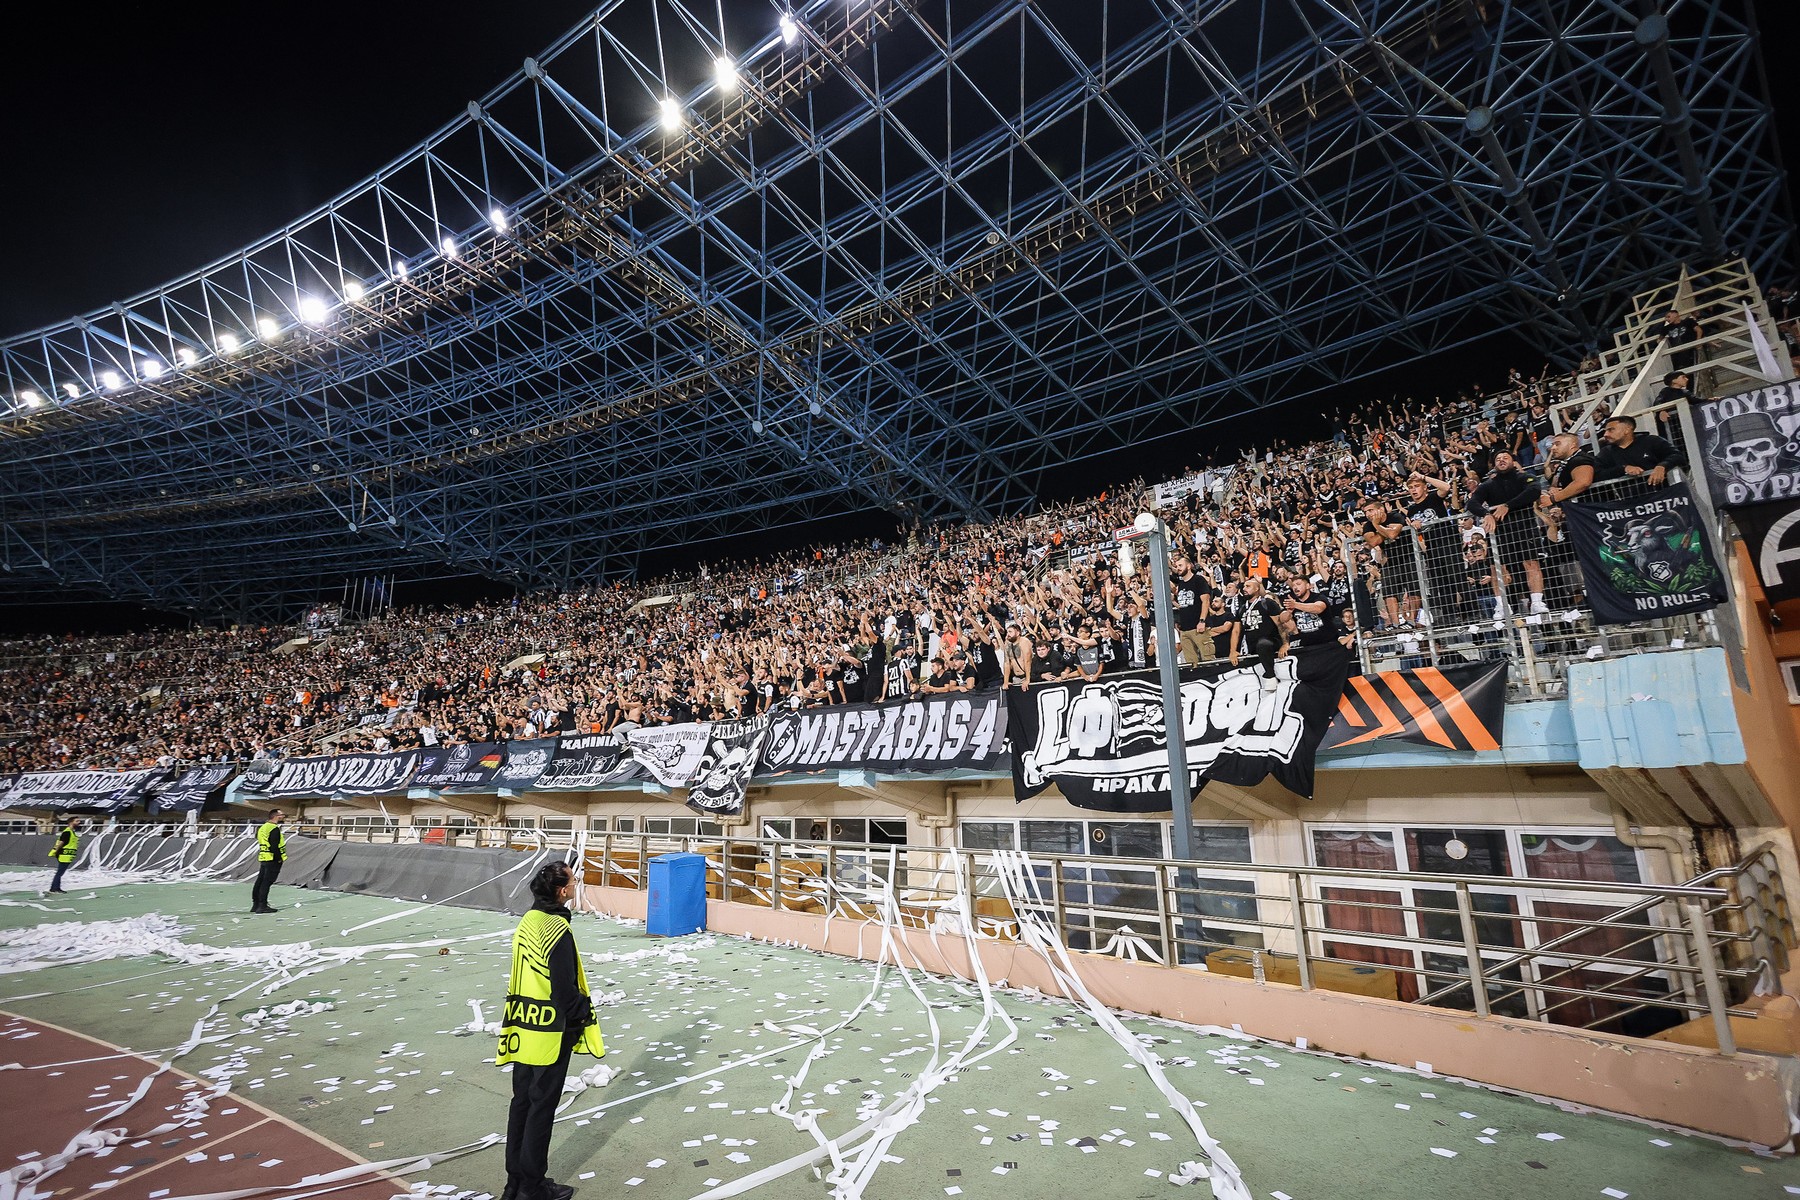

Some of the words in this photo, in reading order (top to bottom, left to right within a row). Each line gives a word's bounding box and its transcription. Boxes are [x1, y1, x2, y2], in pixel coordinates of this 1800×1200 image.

[1596, 508, 1632, 523] PURE
[1634, 596, 1658, 610] NO
[889, 666, 899, 680] 20
[788, 700, 970, 764] MASTABAS
[969, 699, 999, 761] 4
[561, 736, 619, 750] KAMINIA
